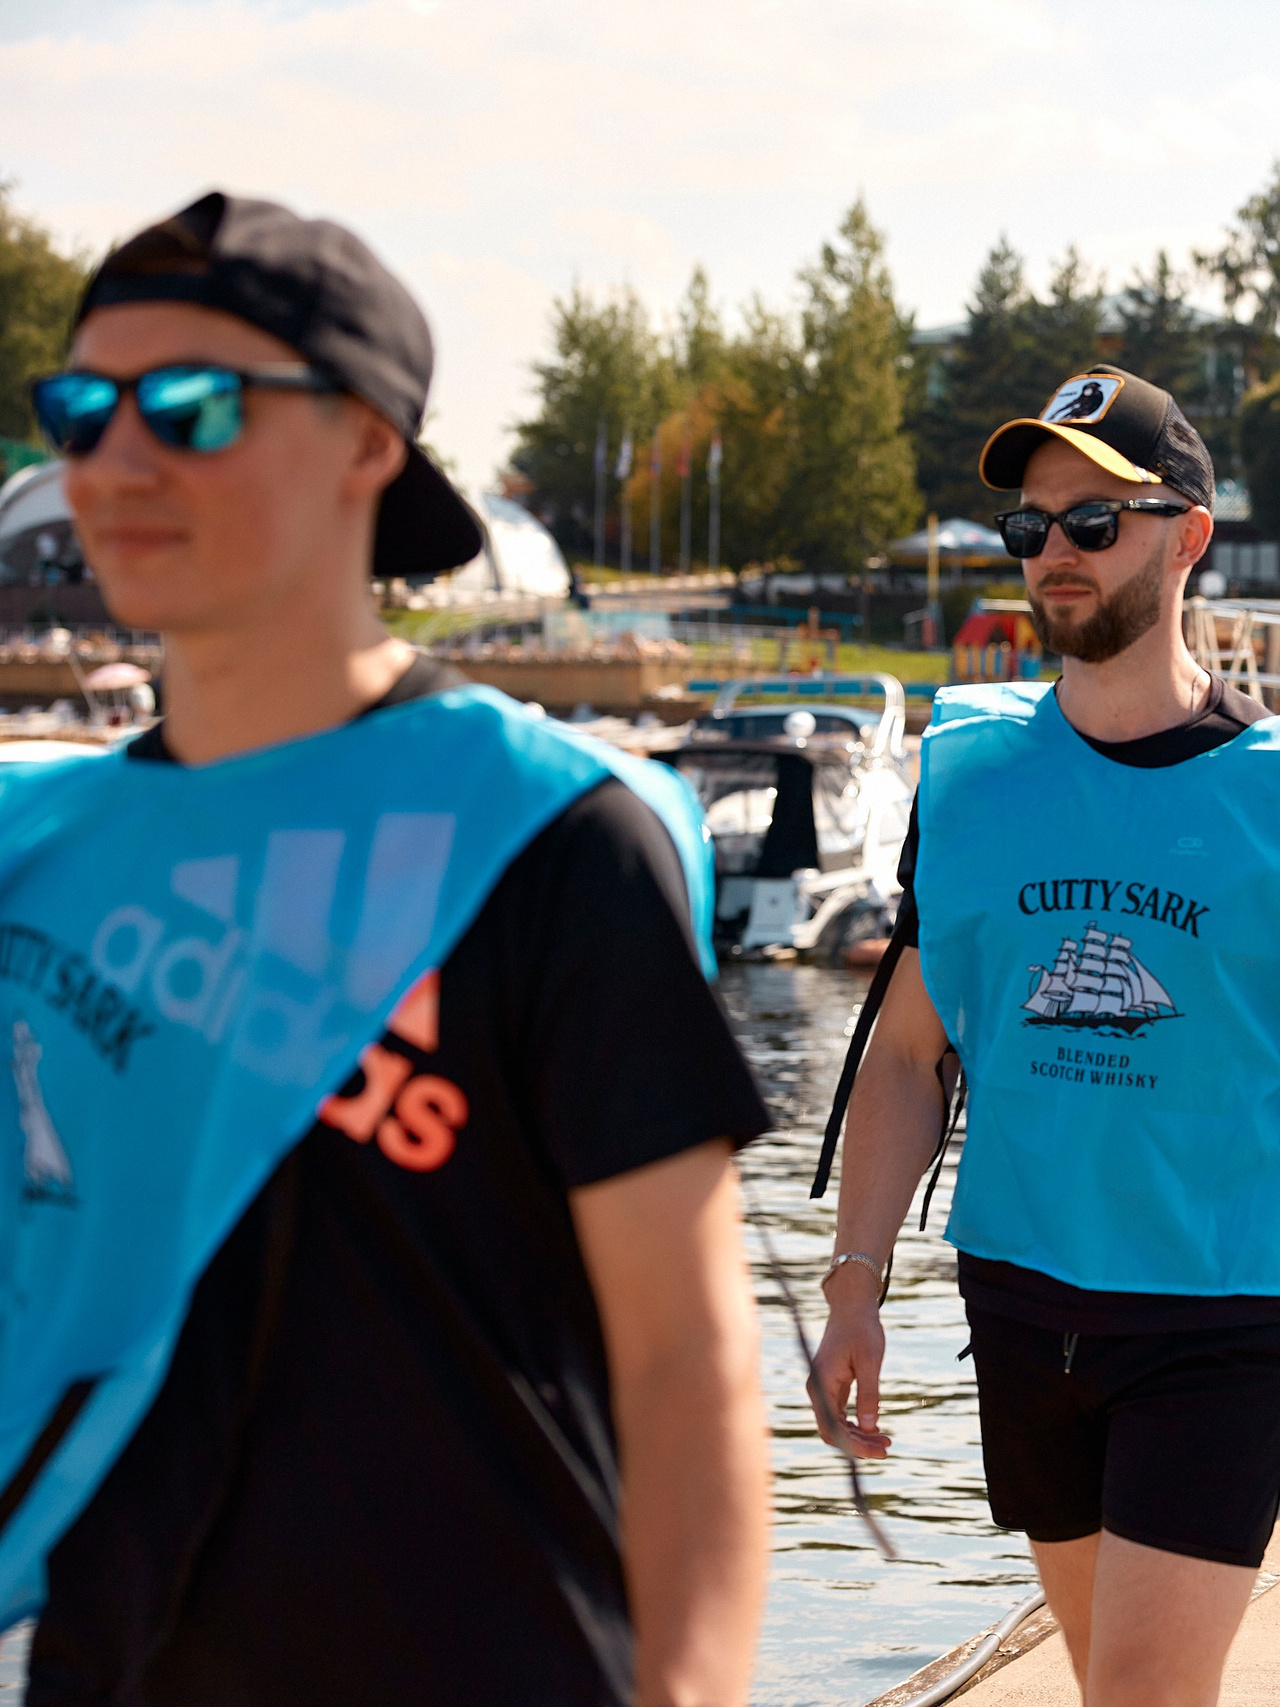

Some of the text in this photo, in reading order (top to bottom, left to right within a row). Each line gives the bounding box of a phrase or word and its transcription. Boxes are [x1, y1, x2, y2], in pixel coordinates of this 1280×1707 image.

[1018, 878, 1210, 939] CUTTY SARK
[46, 952, 157, 1076] SARK
[1030, 1060, 1158, 1089] SCOTCH WHISKY
[1057, 1046, 1131, 1069] BLENDED
